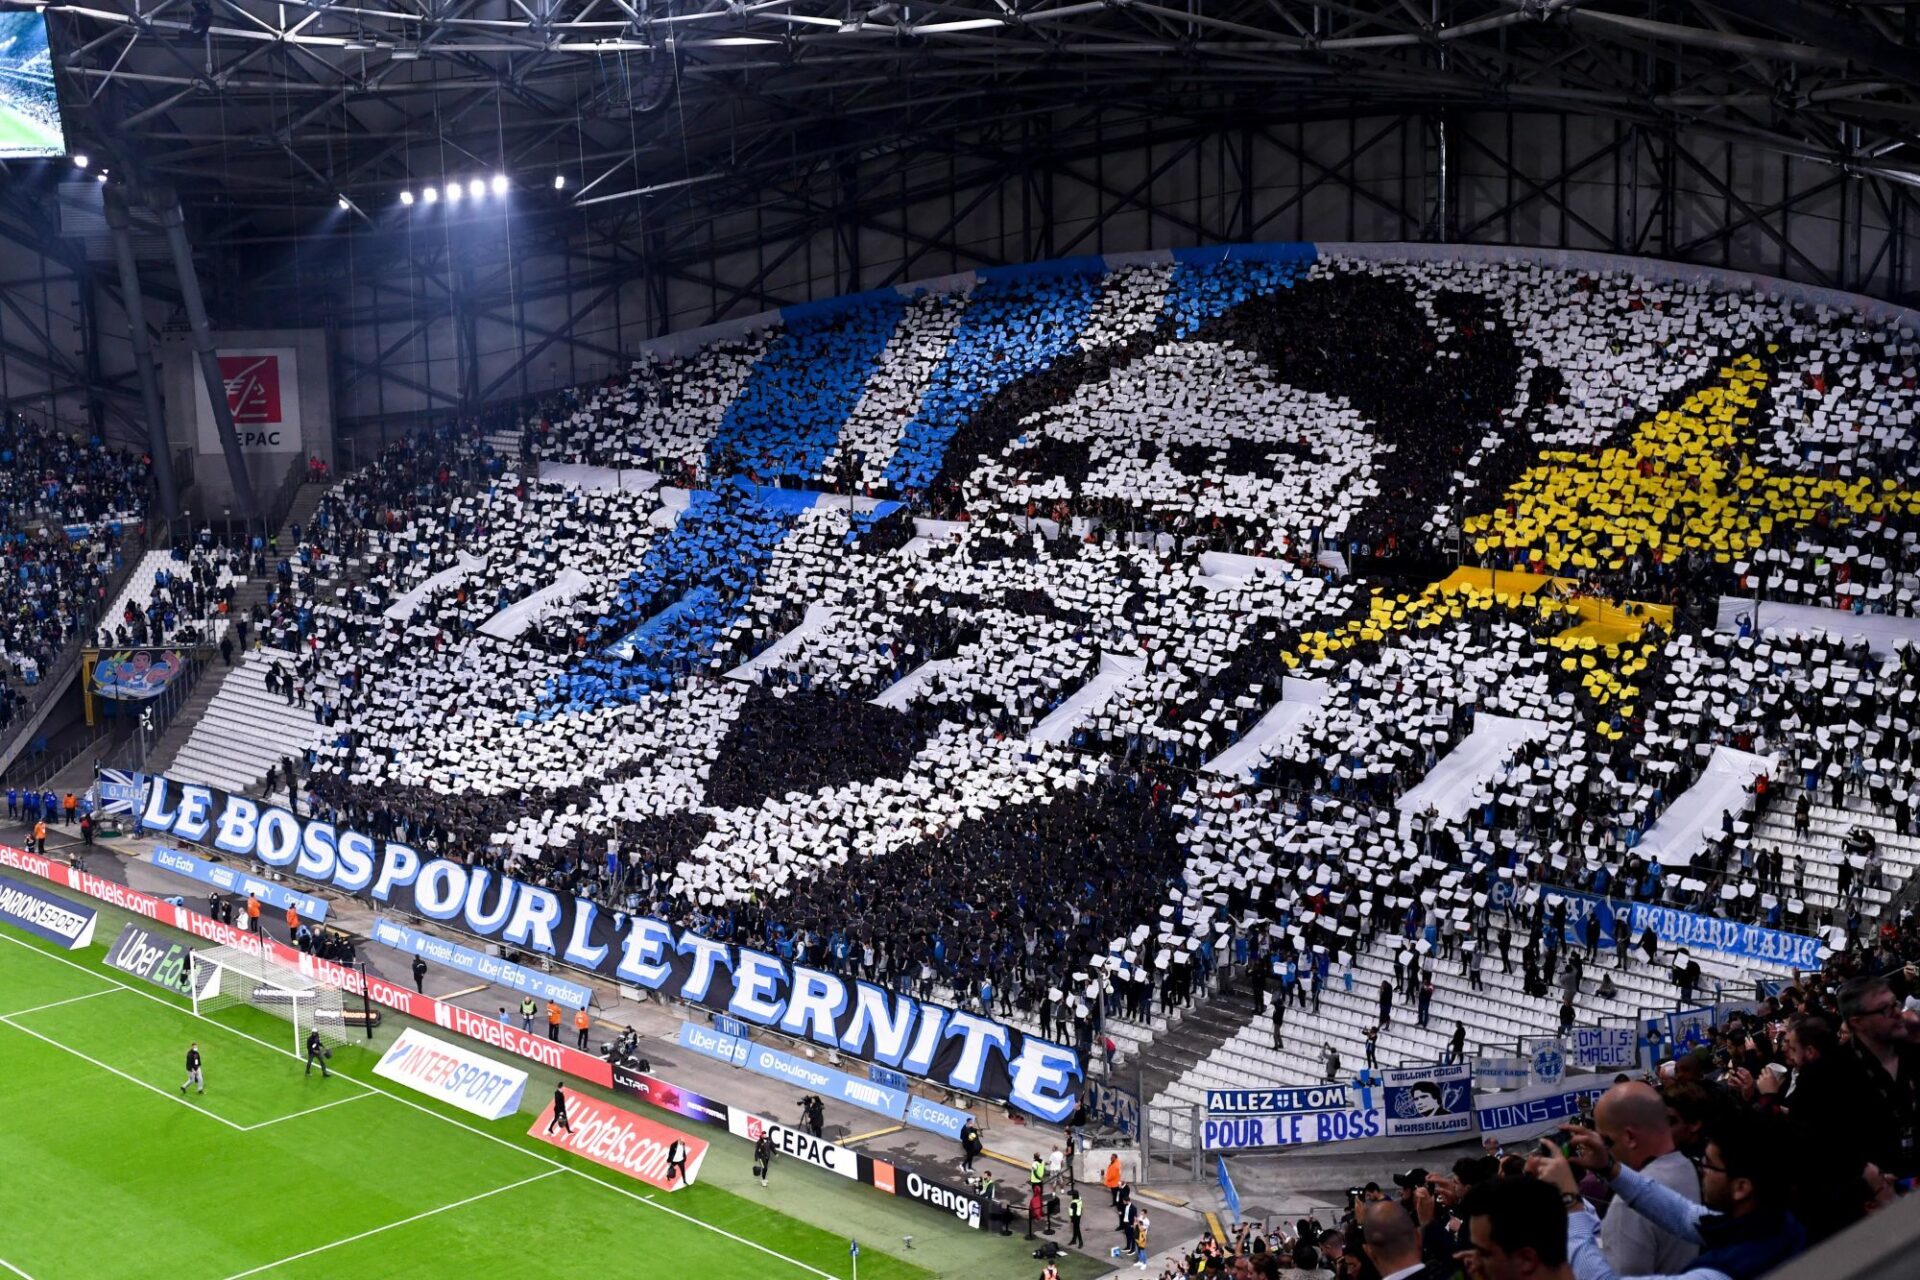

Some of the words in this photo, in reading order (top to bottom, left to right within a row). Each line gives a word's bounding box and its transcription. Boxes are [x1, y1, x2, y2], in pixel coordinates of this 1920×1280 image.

[236, 432, 281, 446] EPAC
[0, 847, 49, 879] els.com
[158, 850, 176, 867] Uber
[82, 872, 158, 919] Hotels.com
[40, 908, 83, 933] SPORT
[191, 912, 273, 963] Hotels.com
[1635, 903, 1739, 950] BERNARD
[1743, 926, 1816, 967] TAPIE
[116, 929, 165, 977] Uber
[141, 774, 212, 841] LE
[214, 795, 375, 892] BOSS
[371, 844, 561, 956] POUR
[563, 896, 1083, 1122] L'ETERNITE
[427, 943, 473, 967] Hotels.com
[478, 958, 502, 978] Uber
[502, 967, 526, 985] Eats
[545, 983, 584, 1005] randstad
[456, 1008, 562, 1070] Hotels.com
[688, 1030, 718, 1051] Uber
[717, 1041, 747, 1062] Eats
[1580, 1048, 1625, 1063] MAGIC
[399, 1045, 513, 1106] INTERSPORT
[614, 1073, 650, 1094] ULTRA
[774, 1060, 829, 1086] boulanger
[844, 1079, 880, 1106] PUMA
[1391, 1070, 1432, 1081] VAILLANT
[1433, 1066, 1463, 1078] COEUR
[1209, 1092, 1274, 1111] ALLEZ
[1292, 1088, 1345, 1109] L'OM
[922, 1110, 959, 1130] CEPAC
[1205, 1119, 1264, 1149] POUR
[1276, 1115, 1303, 1144] LE
[1317, 1109, 1380, 1142] BOSS
[1394, 1118, 1468, 1133] MARSEILLAIS
[560, 1101, 671, 1182] Hotels.com
[768, 1125, 836, 1169] CEPAC
